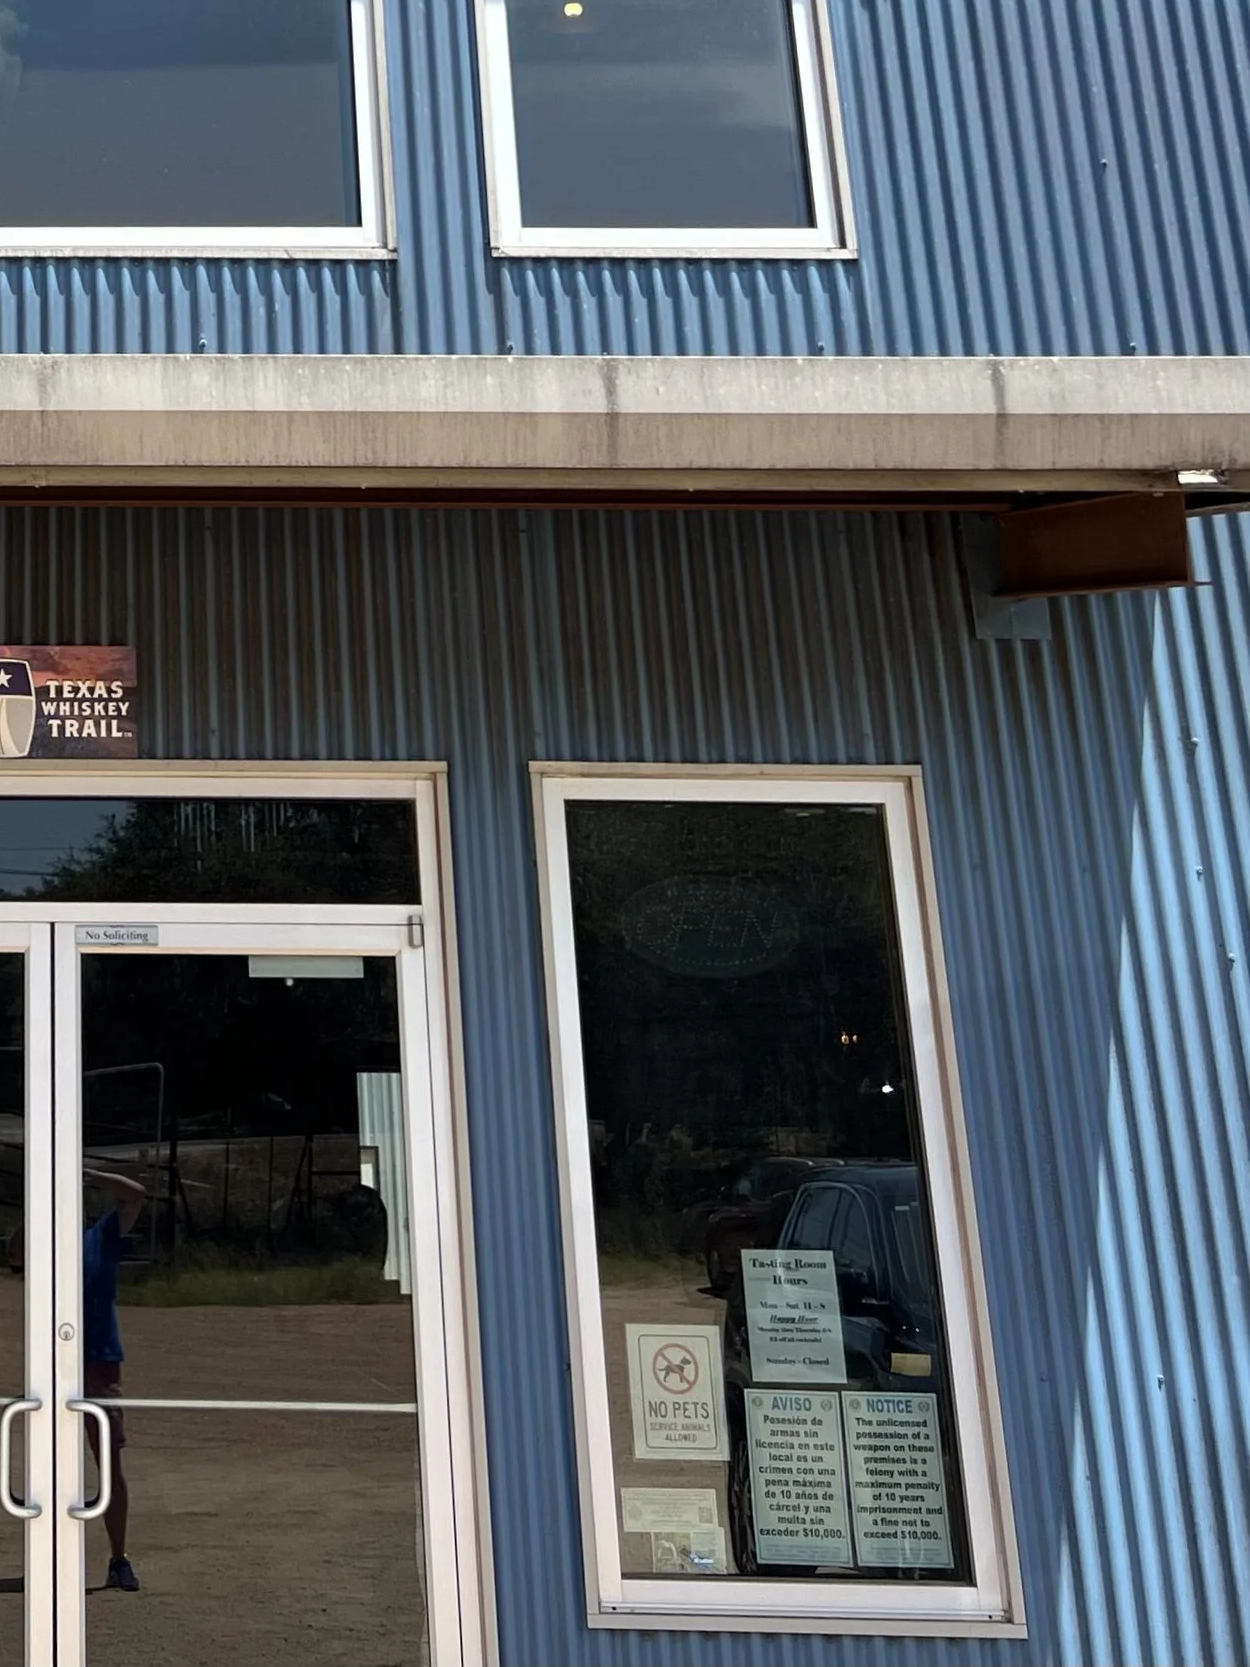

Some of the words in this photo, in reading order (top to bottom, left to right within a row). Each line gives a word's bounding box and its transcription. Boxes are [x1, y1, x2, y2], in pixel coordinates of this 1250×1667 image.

[45, 680, 123, 698] TEXAS
[41, 701, 129, 716] WHISKEY
[47, 719, 123, 737] TRAIL
[86, 930, 100, 940] No
[102, 930, 148, 942] Soliciting
[749, 1258, 791, 1271] Tasting
[794, 1258, 826, 1269] Room
[772, 1275, 808, 1285] Hours
[766, 1357, 795, 1366] Sunday
[803, 1357, 829, 1365] Closed
[772, 1396, 812, 1411] AVISO
[866, 1398, 913, 1413] NOTICE
[648, 1401, 668, 1418] NO
[672, 1401, 710, 1419] PETS
[763, 1415, 808, 1425] Posesión
[811, 1417, 823, 1426] de
[855, 1417, 873, 1426] The
[876, 1418, 928, 1428] unlicensed
[650, 1422, 679, 1432] SERVICE
[681, 1423, 710, 1432] ANIMALS
[665, 1434, 697, 1443] ALLOWED
[770, 1429, 800, 1437] armas
[803, 1429, 818, 1438] sin
[856, 1431, 908, 1440] possession
[911, 1431, 921, 1439] of
[755, 1439, 795, 1449] licencia
[813, 1443, 835, 1451] este
[853, 1444, 890, 1453] weapon
[908, 1444, 934, 1452] these
[769, 1452, 793, 1462] local
[811, 1455, 823, 1463] un
[863, 1456, 907, 1465] premises
[910, 1456, 918, 1464] is
[758, 1464, 793, 1474] crimen
[796, 1467, 814, 1475] con
[817, 1468, 836, 1476] una
[866, 1467, 894, 1478] felony
[897, 1468, 919, 1477] with
[765, 1479, 789, 1487] pena
[792, 1477, 832, 1488] máxima
[855, 1480, 902, 1489] maximum
[905, 1481, 940, 1492] penalty
[764, 1490, 776, 1499] de
[780, 1490, 791, 1499] 10
[795, 1491, 818, 1500] años
[822, 1491, 834, 1501] de
[872, 1493, 882, 1501] of
[885, 1493, 896, 1501] 10
[899, 1495, 925, 1503] years
[769, 1502, 801, 1512] cárcel
[804, 1505, 810, 1514] y
[857, 1505, 922, 1515] imprisonment
[777, 1516, 806, 1524] multa
[810, 1516, 824, 1525] sin
[880, 1517, 899, 1526] fine
[902, 1519, 917, 1527] not
[920, 1519, 930, 1527] to
[759, 1528, 799, 1537] exceder
[802, 1528, 846, 1540] $10,000.
[863, 1530, 898, 1539] exceed
[901, 1530, 942, 1541] $10,000.
